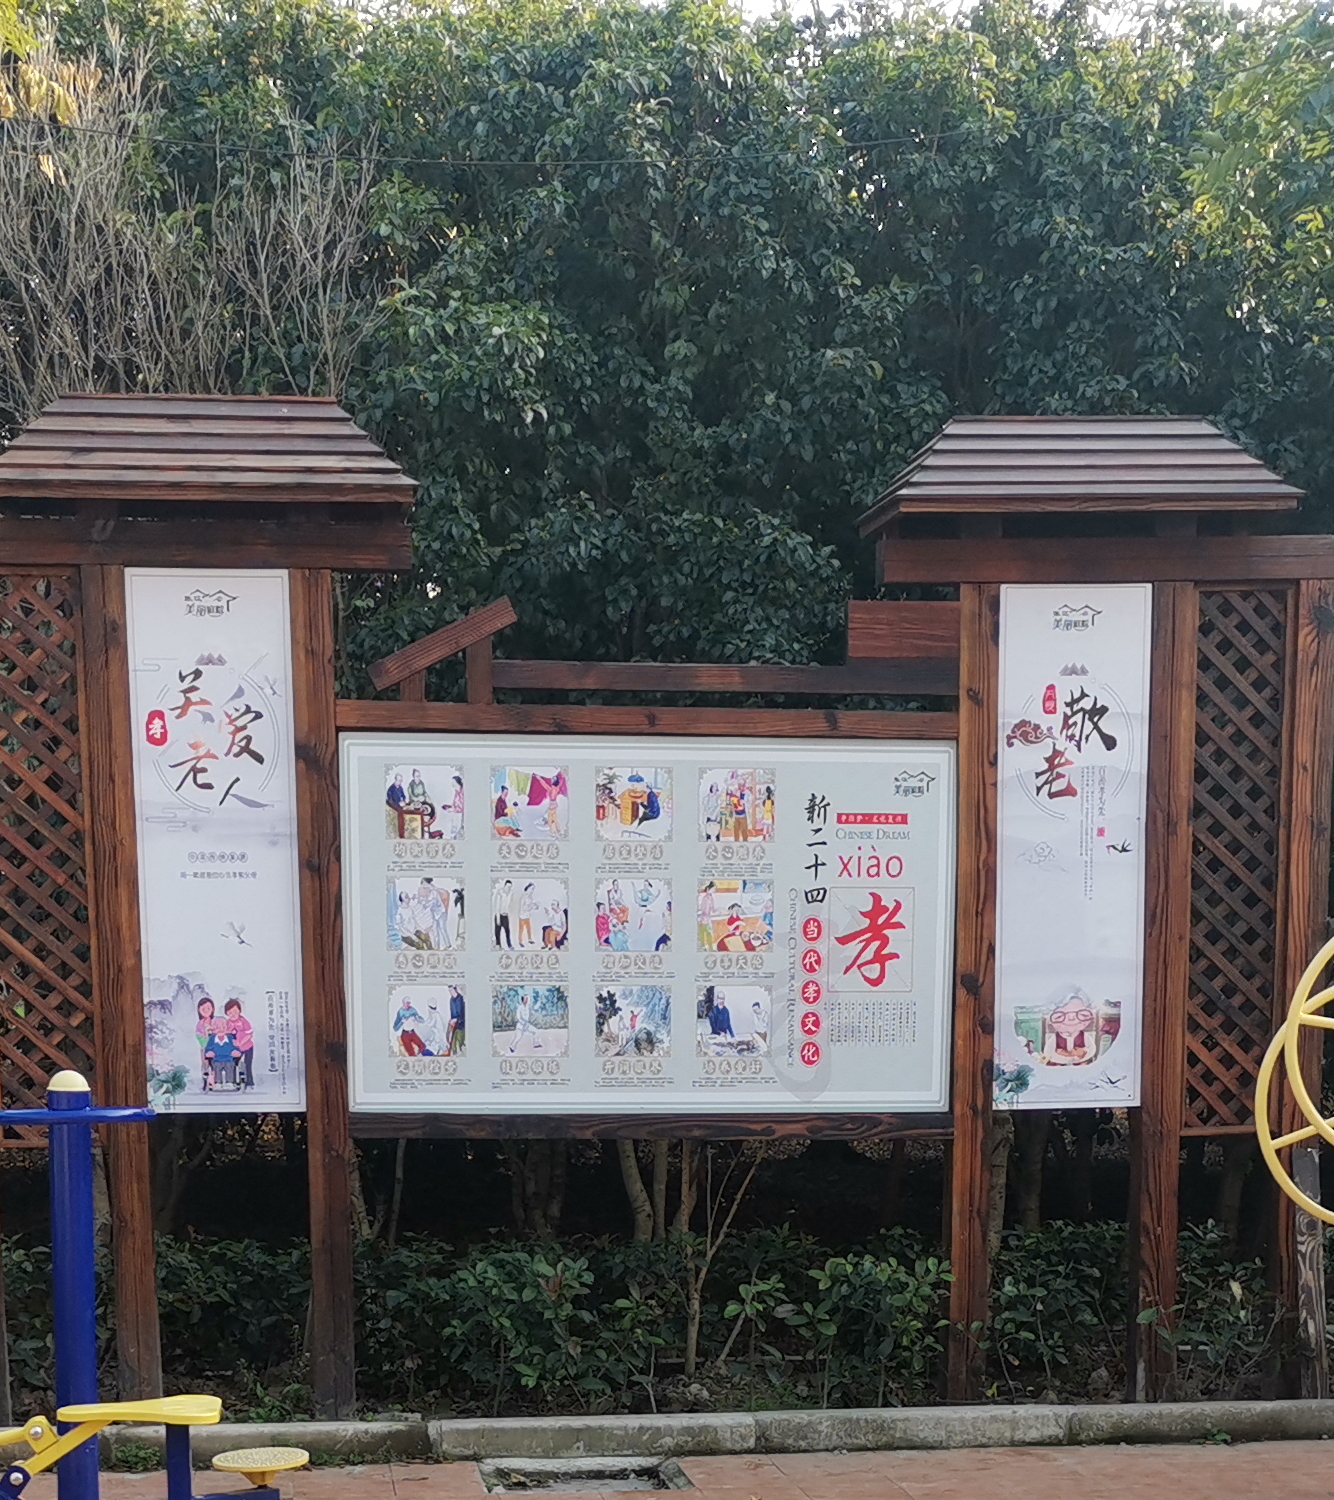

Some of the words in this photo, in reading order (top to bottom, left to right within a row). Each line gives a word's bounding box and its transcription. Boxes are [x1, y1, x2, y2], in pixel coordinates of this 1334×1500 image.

[1035, 685, 1118, 801] 敬老
[804, 793, 831, 904] 新二十四
[838, 845, 903, 878] xiào
[801, 917, 821, 1065] 当代孝文化
[835, 891, 906, 987] 孝
